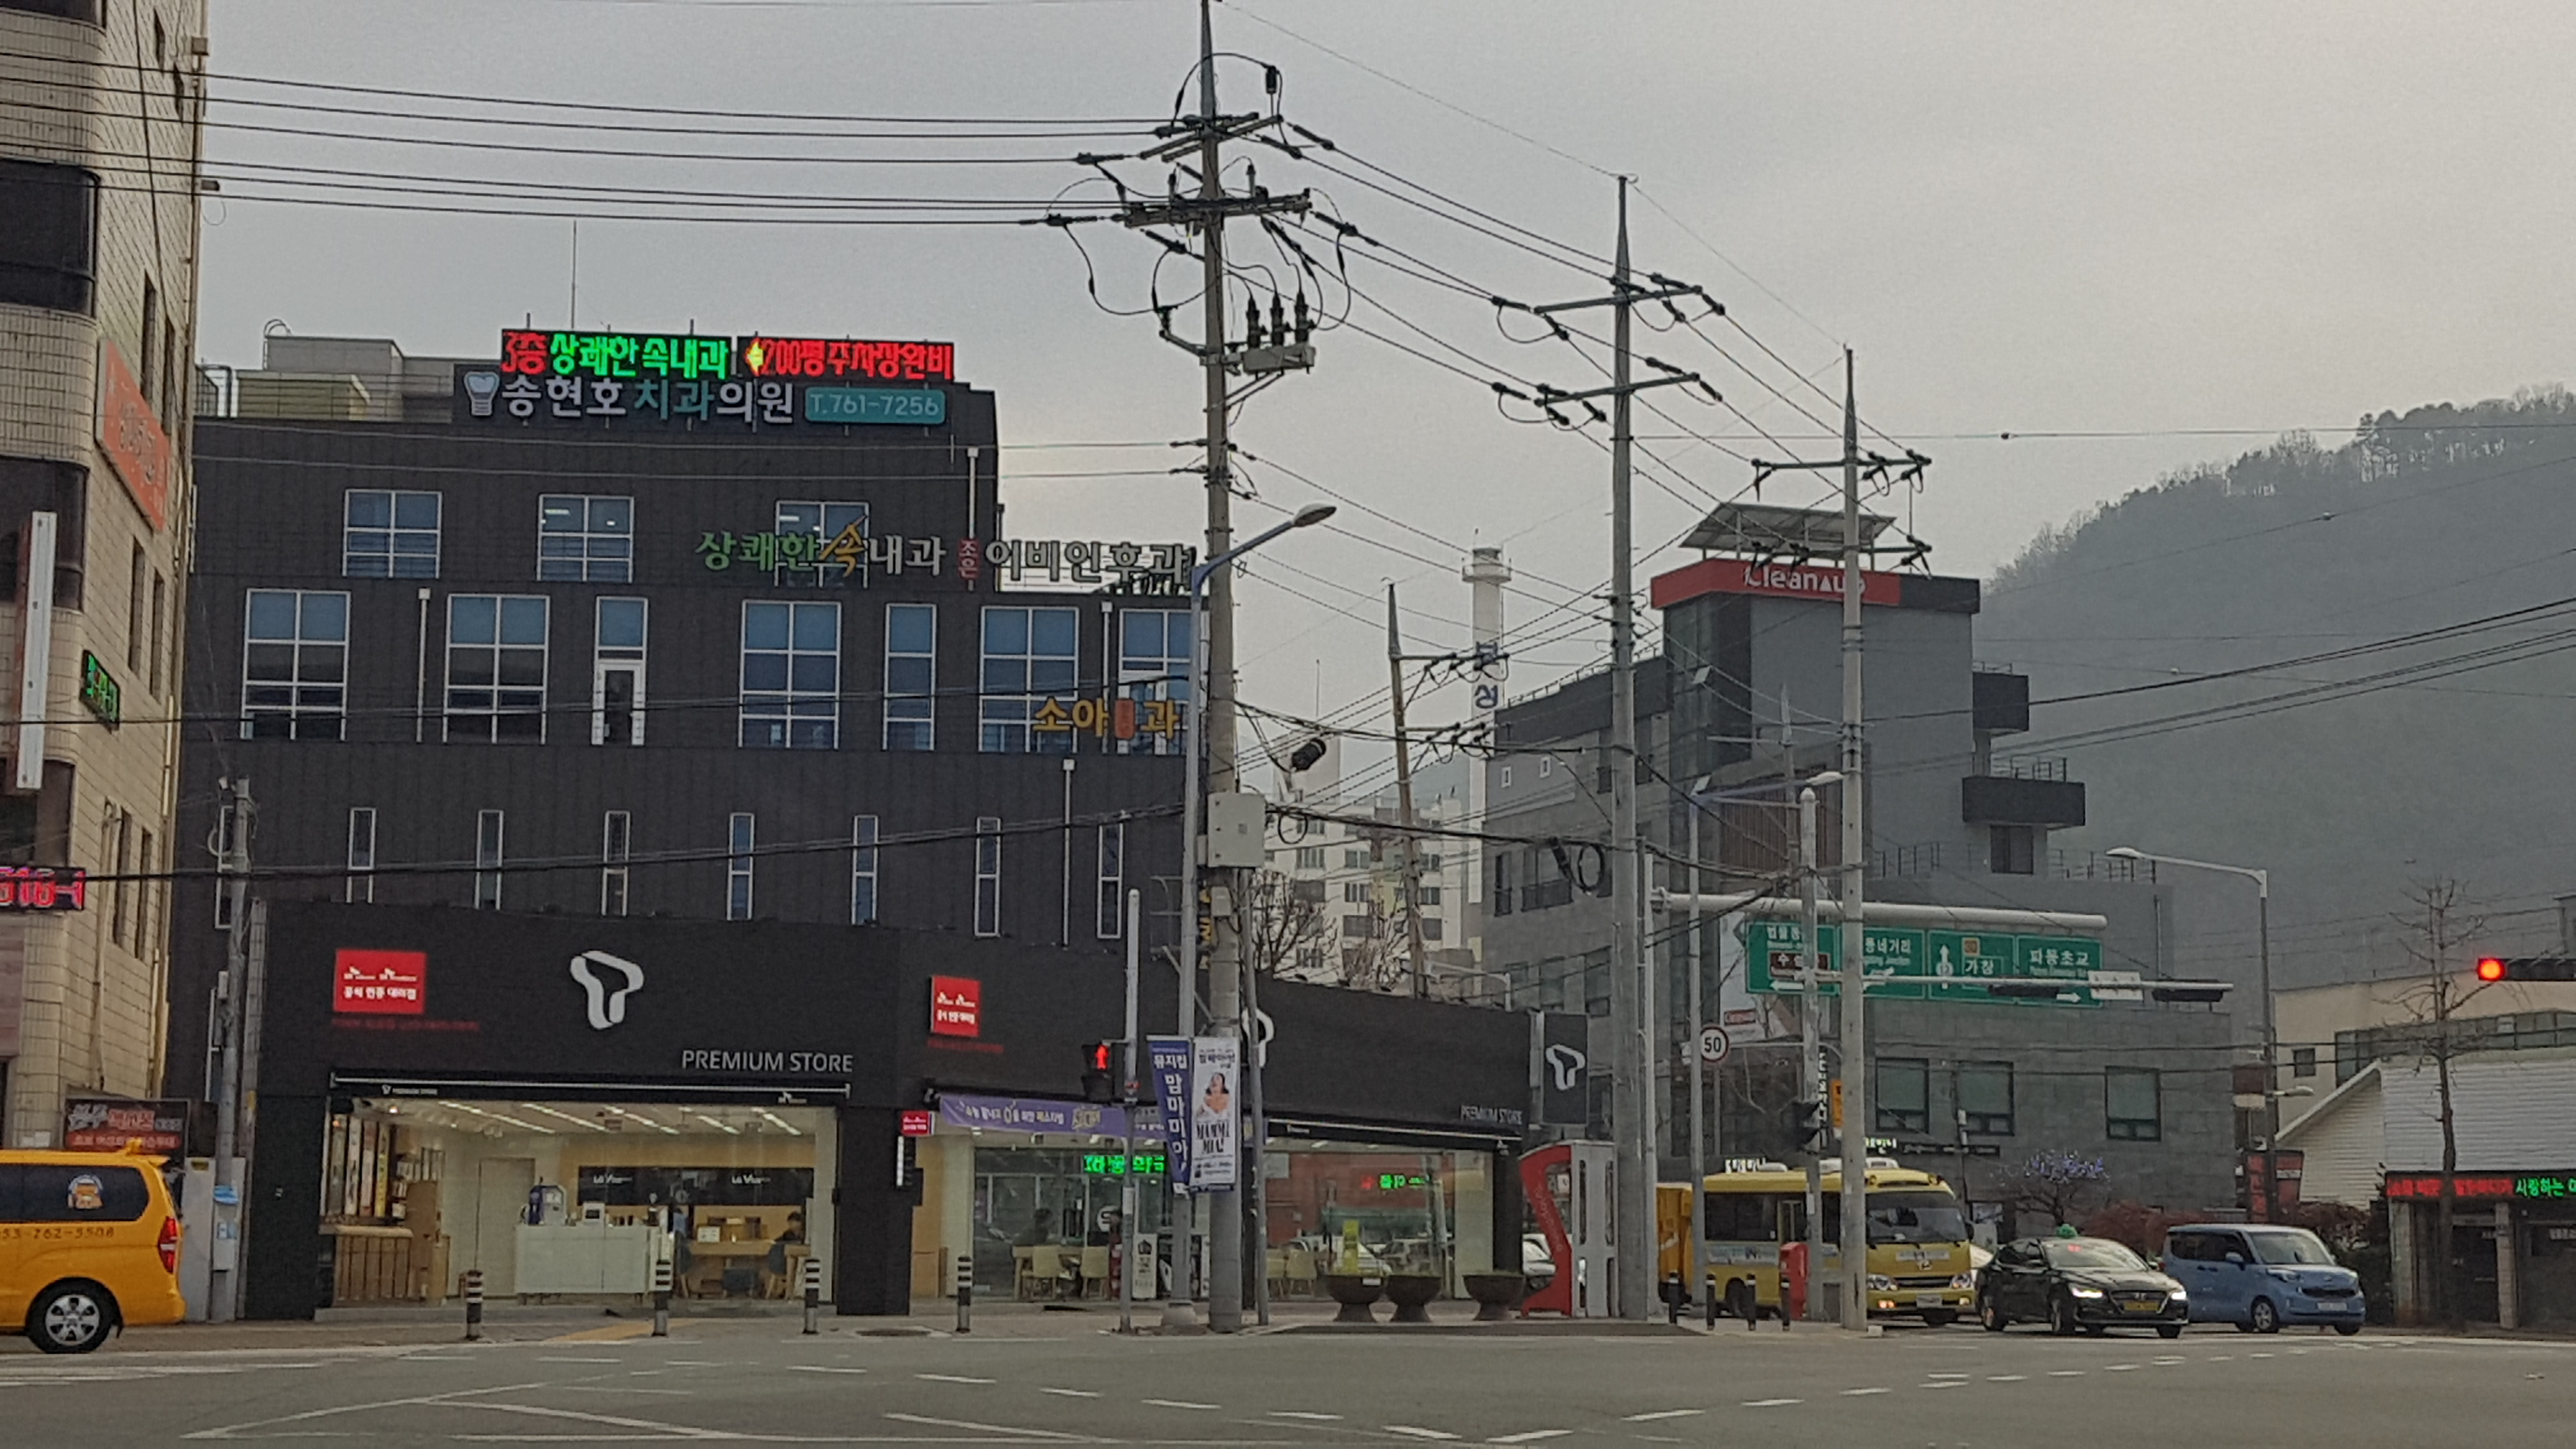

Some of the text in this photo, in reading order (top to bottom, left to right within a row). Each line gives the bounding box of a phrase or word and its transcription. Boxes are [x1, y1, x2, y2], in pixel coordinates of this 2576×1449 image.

[1704, 1037, 1722, 1053] 50
[682, 1050, 854, 1073] PREMIUM STORE
